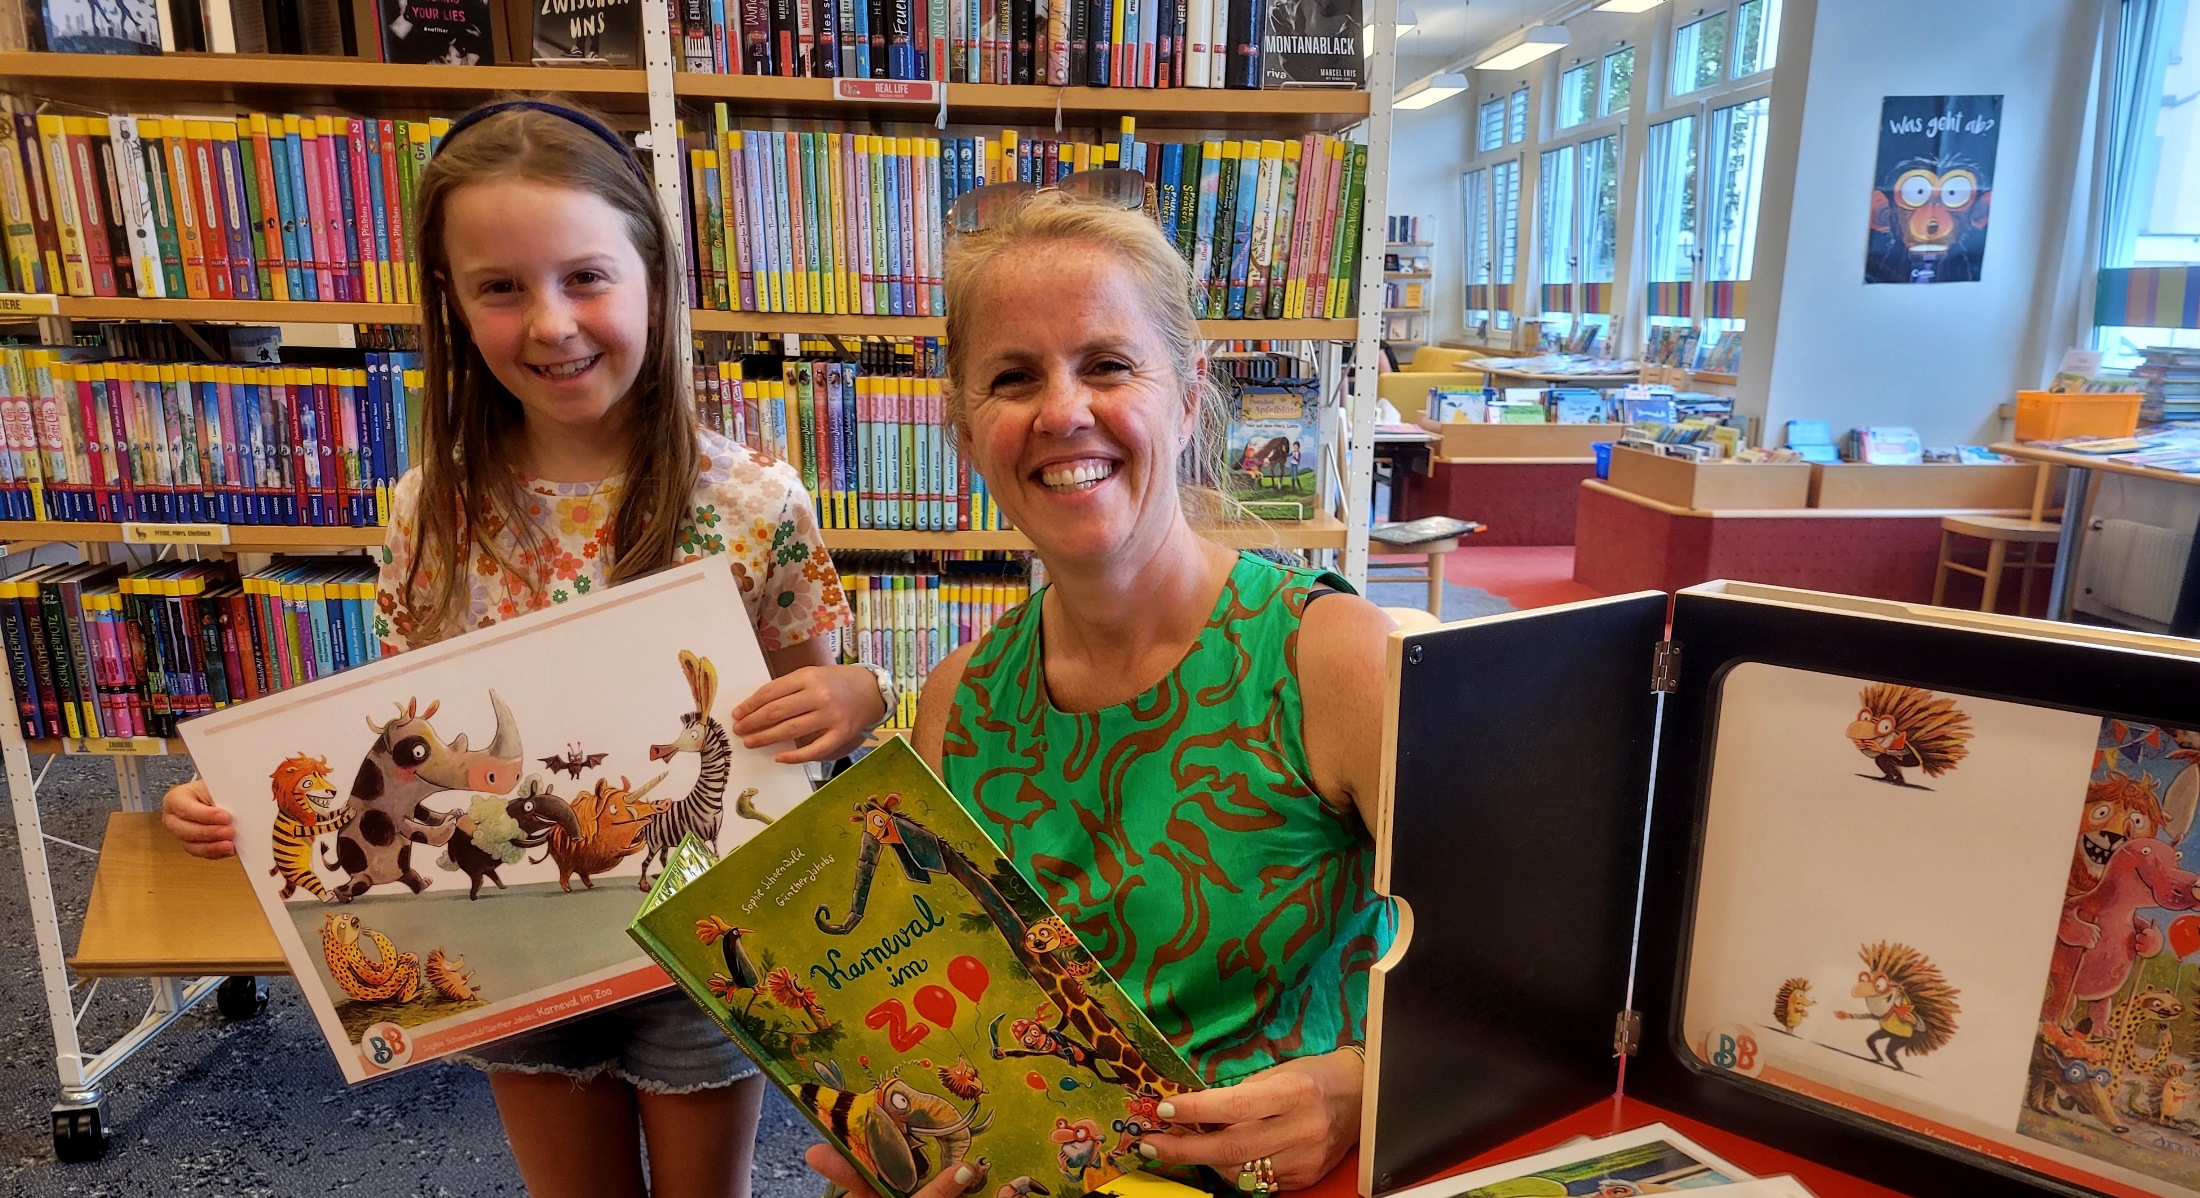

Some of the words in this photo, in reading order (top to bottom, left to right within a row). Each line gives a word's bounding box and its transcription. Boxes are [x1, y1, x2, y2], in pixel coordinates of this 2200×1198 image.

[411, 5, 439, 21] YOUR
[442, 9, 466, 23] LIES
[570, 12, 605, 39] UNS
[1265, 35, 1355, 56] MONTANABLACK
[1266, 68, 1287, 79] riva
[1320, 68, 1341, 78] MARCEL
[1343, 69, 1357, 78] ERIS
[875, 82, 893, 94] REAL
[894, 83, 909, 94] LIFE
[352, 123, 359, 134] 2
[384, 123, 392, 134] 4
[399, 124, 406, 134] 5
[1889, 116, 1923, 135] Was
[1926, 111, 1964, 138] geht
[1964, 114, 1996, 137] ab?
[741, 888, 765, 915] Sophie
[763, 847, 806, 891] Schoenwald
[775, 876, 809, 907] Günther
[807, 853, 836, 884] Jakobs
[810, 894, 945, 990] Karneval
[889, 958, 929, 988] im
[537, 996, 580, 1018] Karneval
[580, 994, 594, 1006] im
[595, 986, 613, 1002] Zoo
[650, 951, 670, 972] Sophie
[668, 967, 705, 1009] Schoenwald
[706, 1009, 731, 1036] Günther
[730, 1034, 750, 1056] Jakobs
